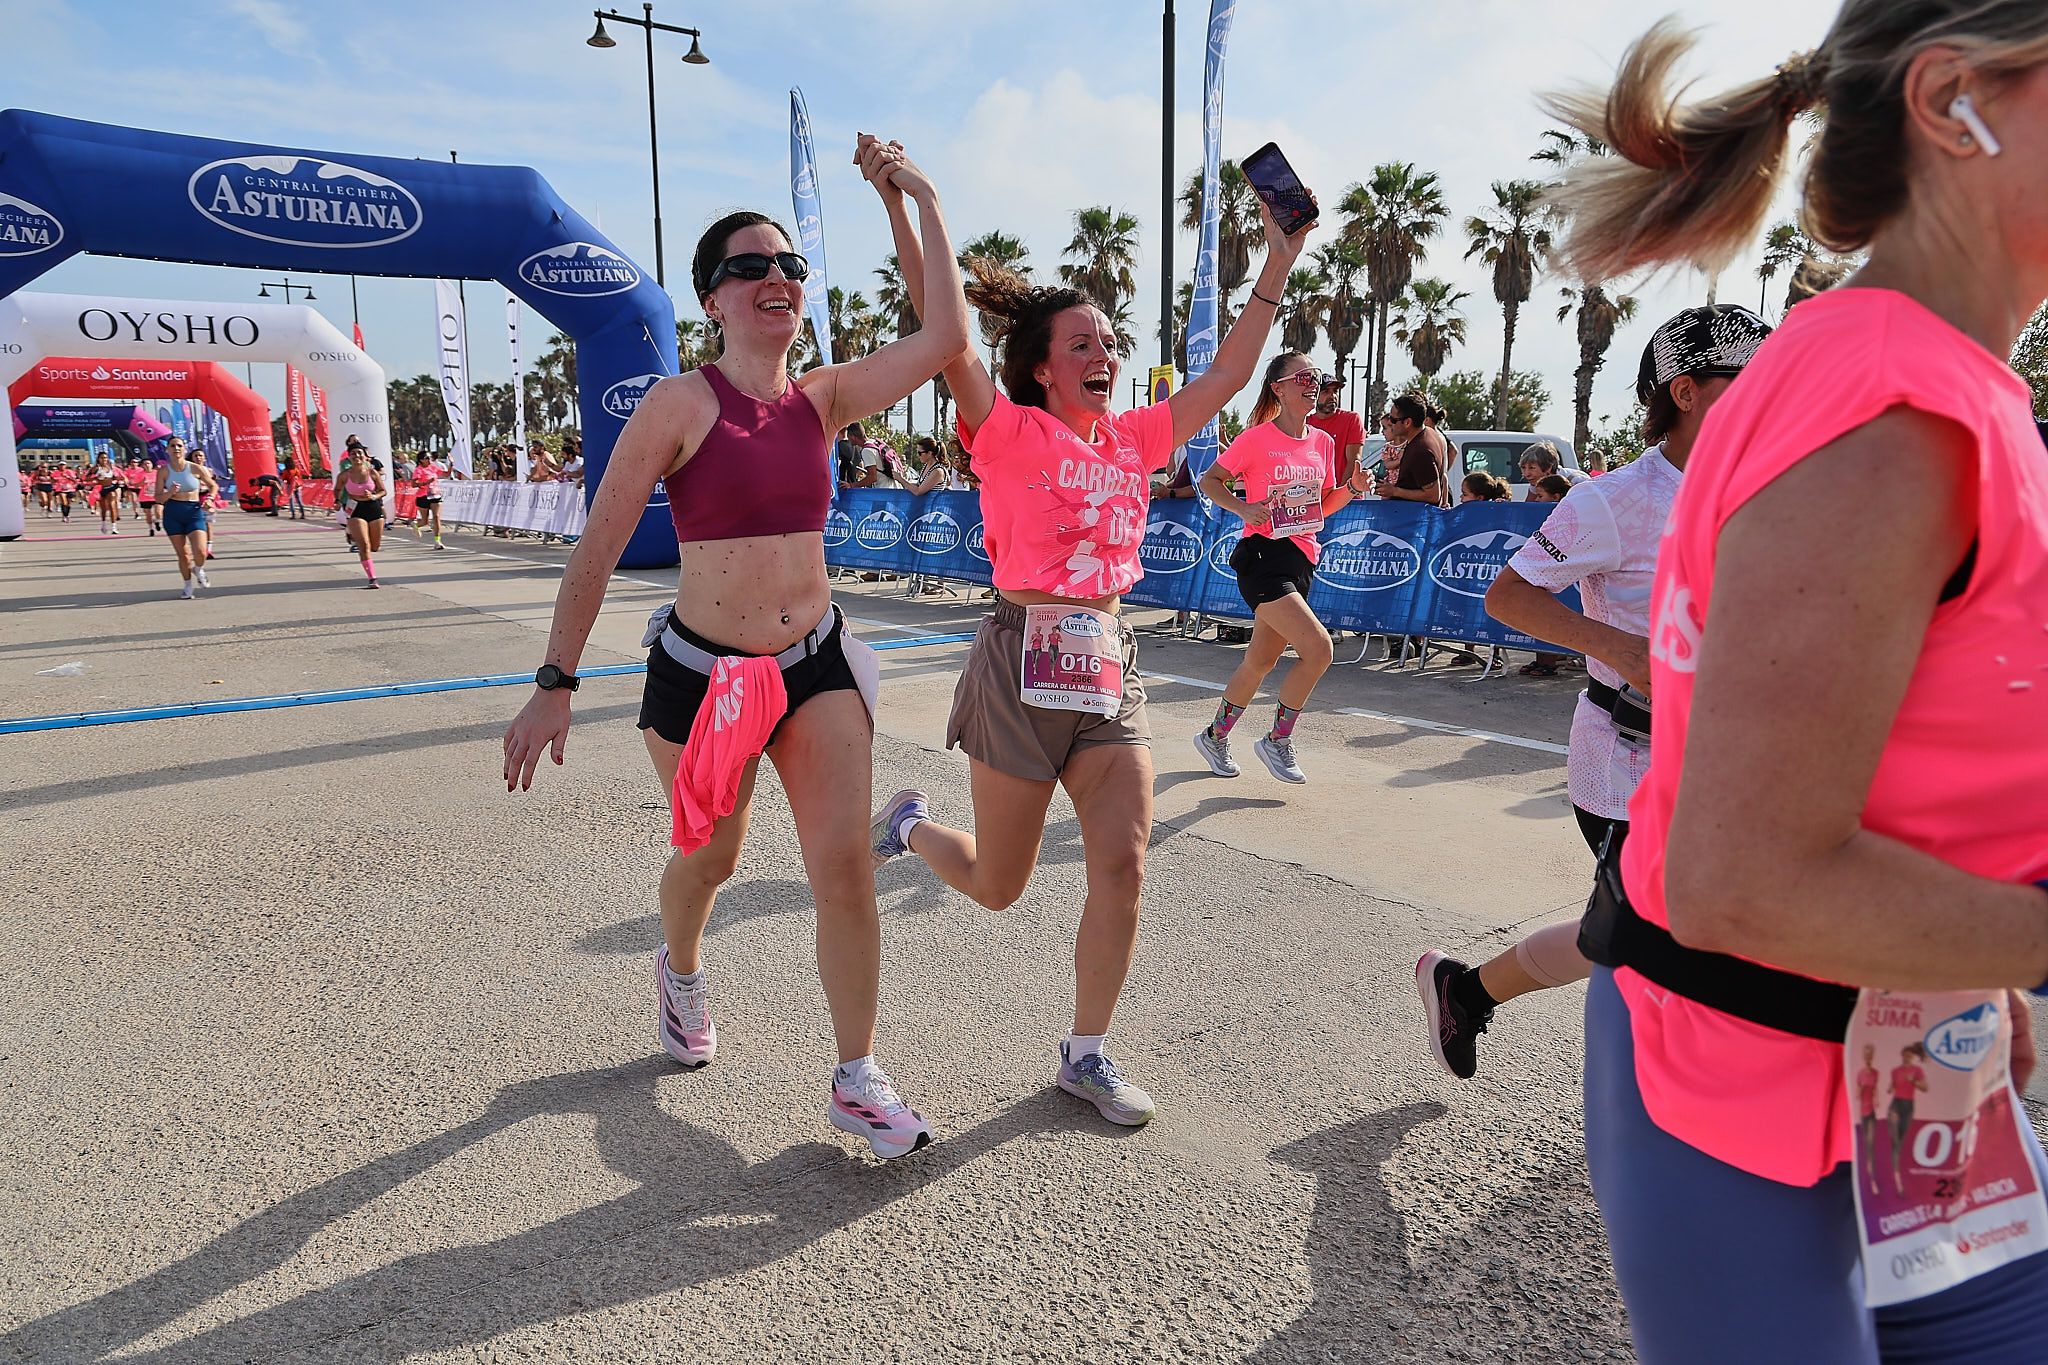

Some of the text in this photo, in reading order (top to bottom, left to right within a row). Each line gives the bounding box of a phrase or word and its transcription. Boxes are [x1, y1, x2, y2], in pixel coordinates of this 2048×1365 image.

[244, 175, 398, 201] CENTRAL LECHERA
[208, 174, 407, 230] ASTURIANA
[529, 262, 635, 283] ASTURIANA
[78, 308, 260, 347] OYSHO
[309, 351, 357, 362] OYSHO
[39, 366, 188, 382] Sports Santander
[339, 413, 383, 423] OYSHO
[1274, 465, 1324, 481] CARRERA
[1287, 505, 1307, 517] 016
[858, 524, 898, 540] ASTURIANA
[909, 526, 955, 545] ASTURIANA
[1373, 550, 1410, 558] LECHERA
[1460, 552, 1500, 561] CENTRAL
[1316, 550, 1410, 577] ASTURIANA
[1060, 653, 1102, 674] 016
[1033, 681, 1059, 689] CARRERA
[1077, 685, 1096, 693] MUJER
[1071, 674, 1092, 684] 2366
[1034, 693, 1070, 704] OYSHO
[1866, 1010, 1921, 1029] SUMA
